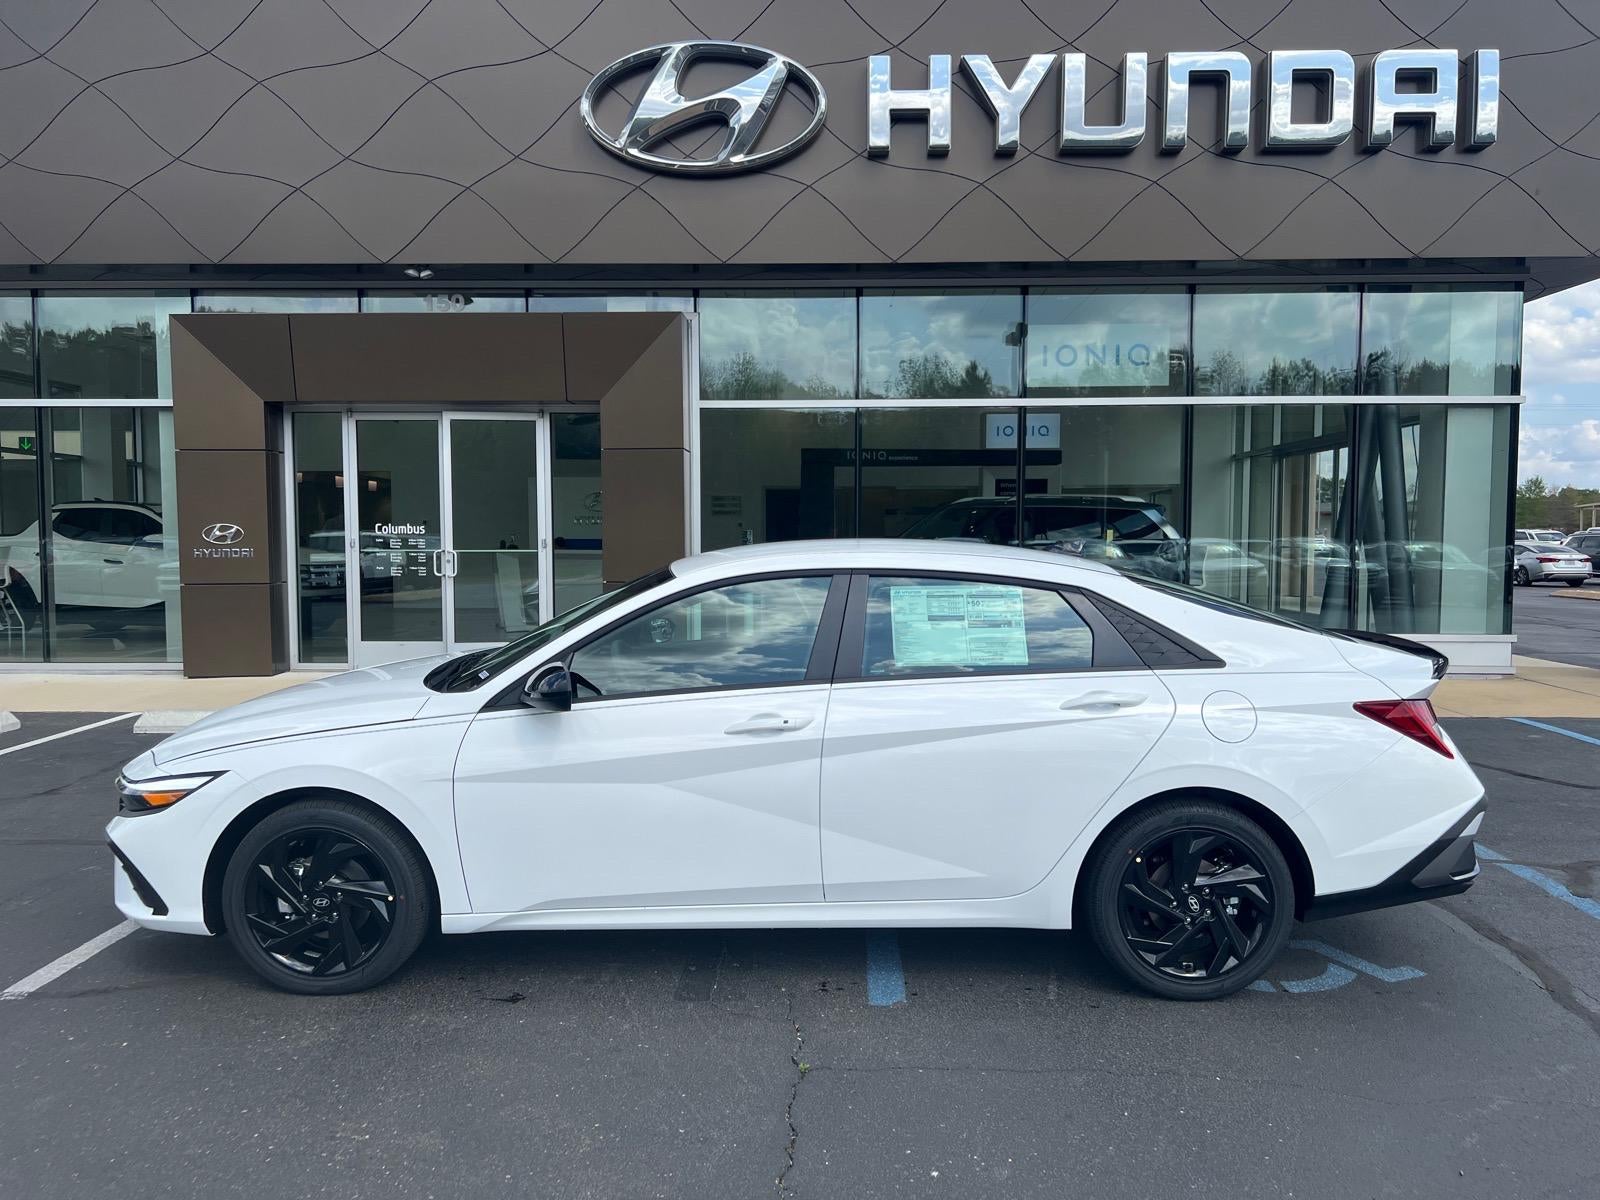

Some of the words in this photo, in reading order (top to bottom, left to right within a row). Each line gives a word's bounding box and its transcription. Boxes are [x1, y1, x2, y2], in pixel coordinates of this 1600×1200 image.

[867, 49, 1499, 153] HYUNDAI
[424, 294, 465, 312] 150
[1042, 343, 1150, 367] IONIQ
[996, 425, 1050, 437] IOIQ
[375, 523, 426, 534] Columbus
[193, 548, 254, 558] HYUNDAI
